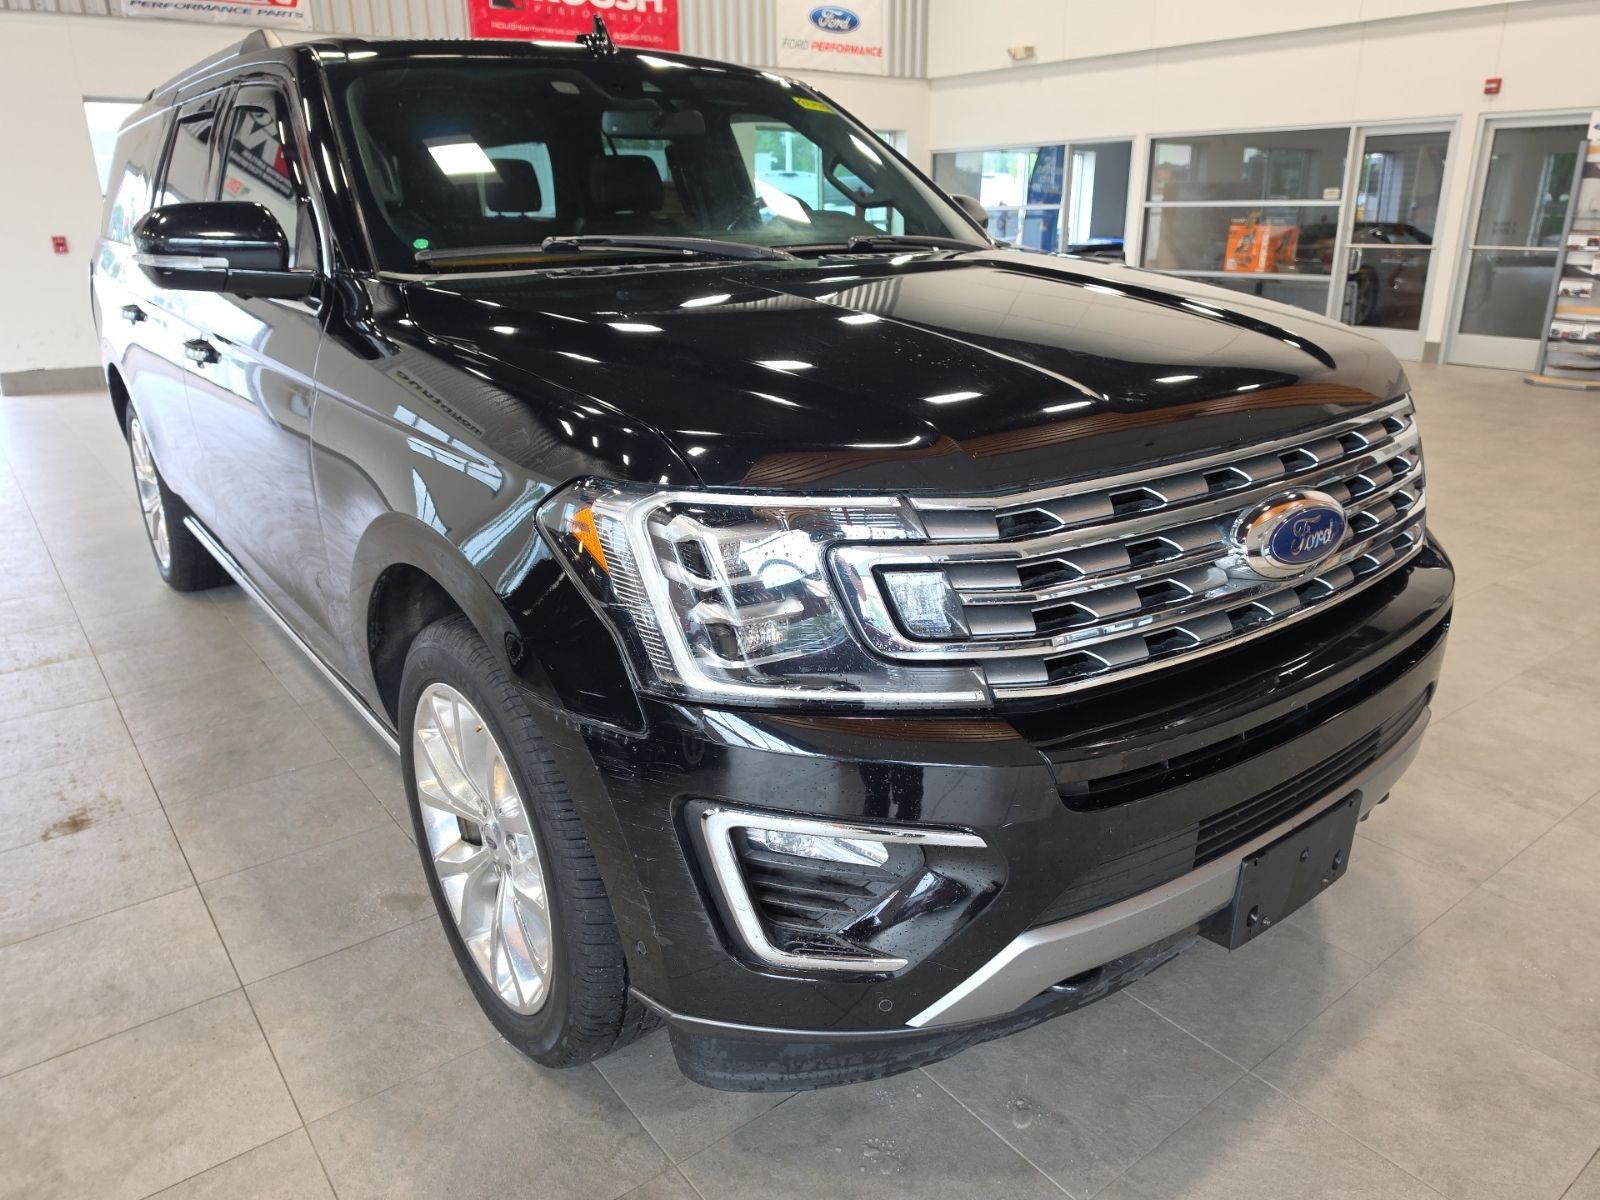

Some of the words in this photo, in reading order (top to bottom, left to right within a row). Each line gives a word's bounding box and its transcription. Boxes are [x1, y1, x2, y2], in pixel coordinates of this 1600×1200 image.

[130, 0, 251, 14] PERFORMANCE
[257, 9, 304, 18] PARTS
[818, 9, 852, 30] Ford
[783, 38, 809, 50] FORD
[812, 41, 882, 57] PERFORMANCE
[1290, 514, 1335, 557] Ford
